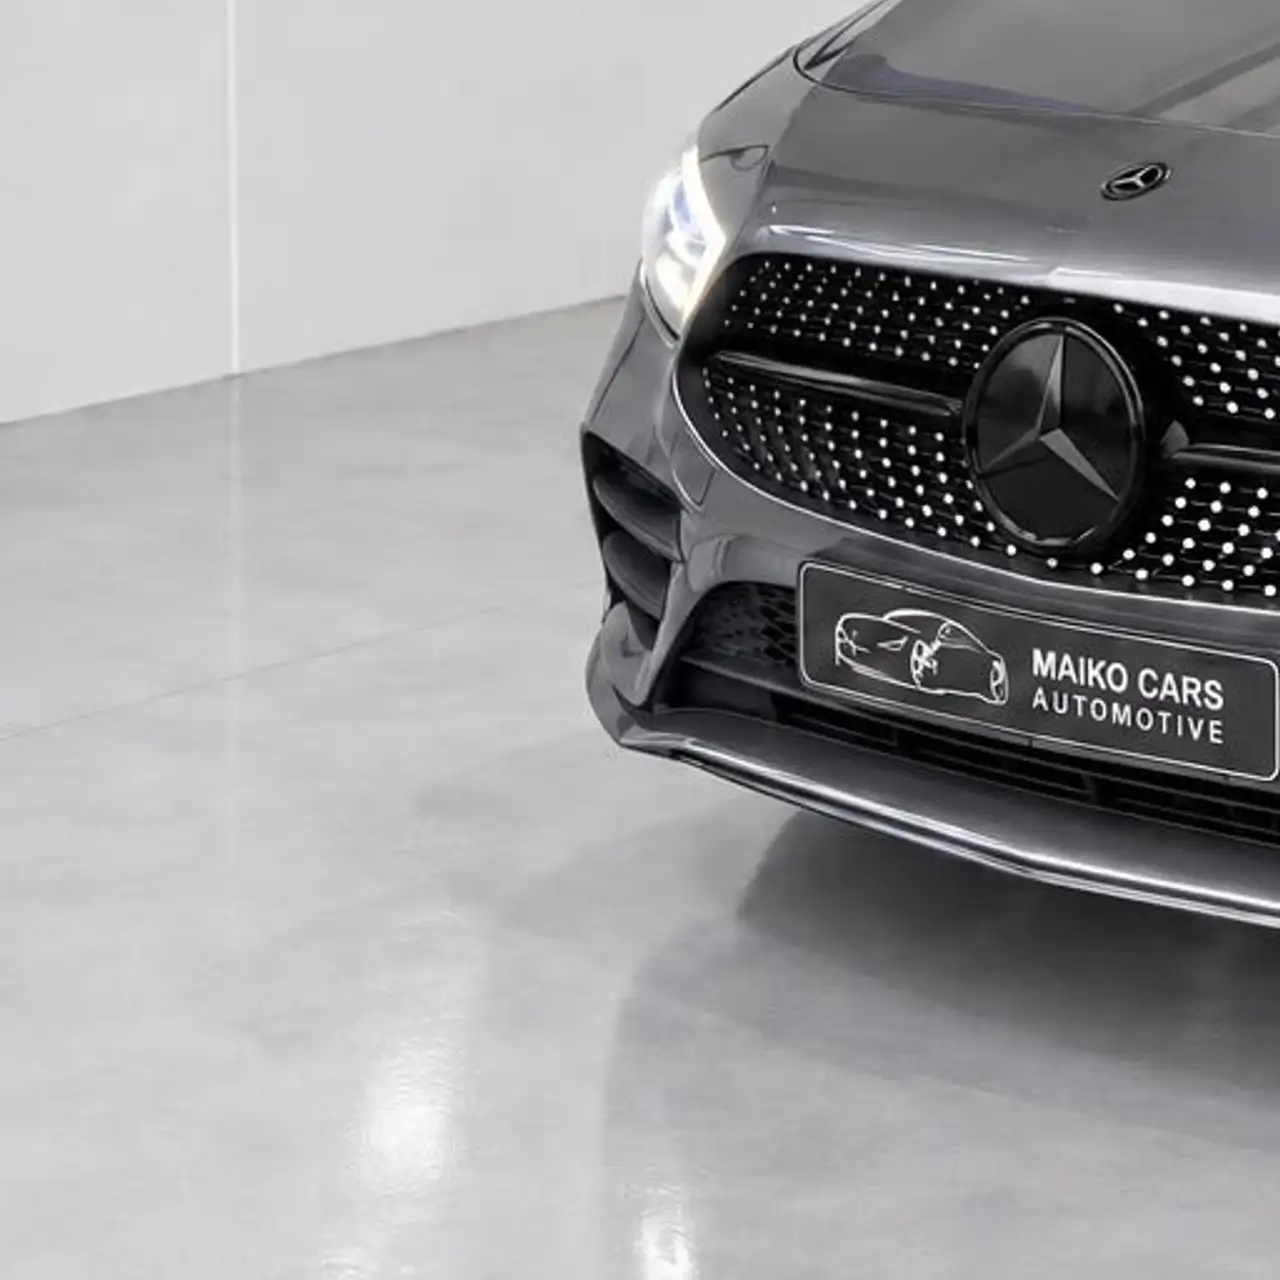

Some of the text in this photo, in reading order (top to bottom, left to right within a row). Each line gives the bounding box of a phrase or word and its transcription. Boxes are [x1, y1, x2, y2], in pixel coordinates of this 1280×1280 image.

[1031, 646, 1225, 712] MAIKO CARS
[1031, 685, 1225, 745] AUTOMOTIVE
